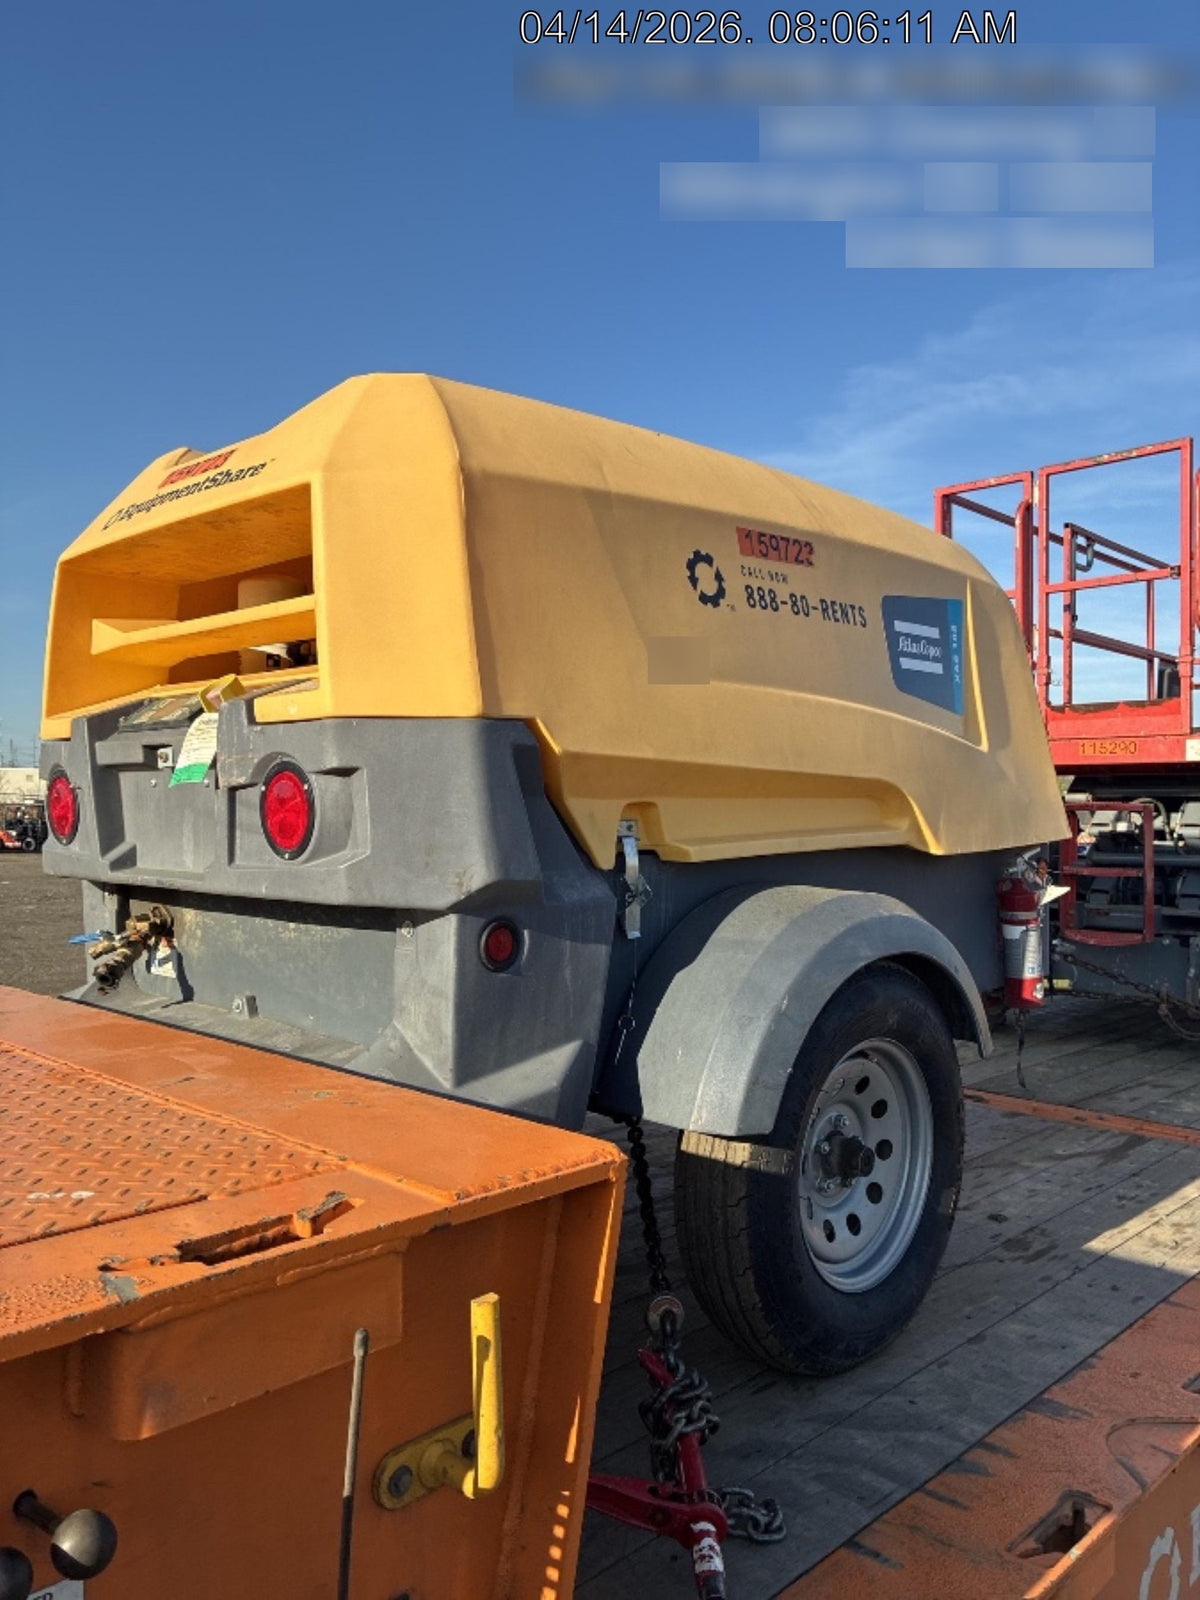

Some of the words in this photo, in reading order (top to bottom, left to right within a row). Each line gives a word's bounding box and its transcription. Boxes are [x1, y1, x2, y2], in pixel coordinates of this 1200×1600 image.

[740, 564, 765, 581] CALL
[744, 584, 868, 628] 888-80-RENTS
[1080, 740, 1137, 755] 115290
